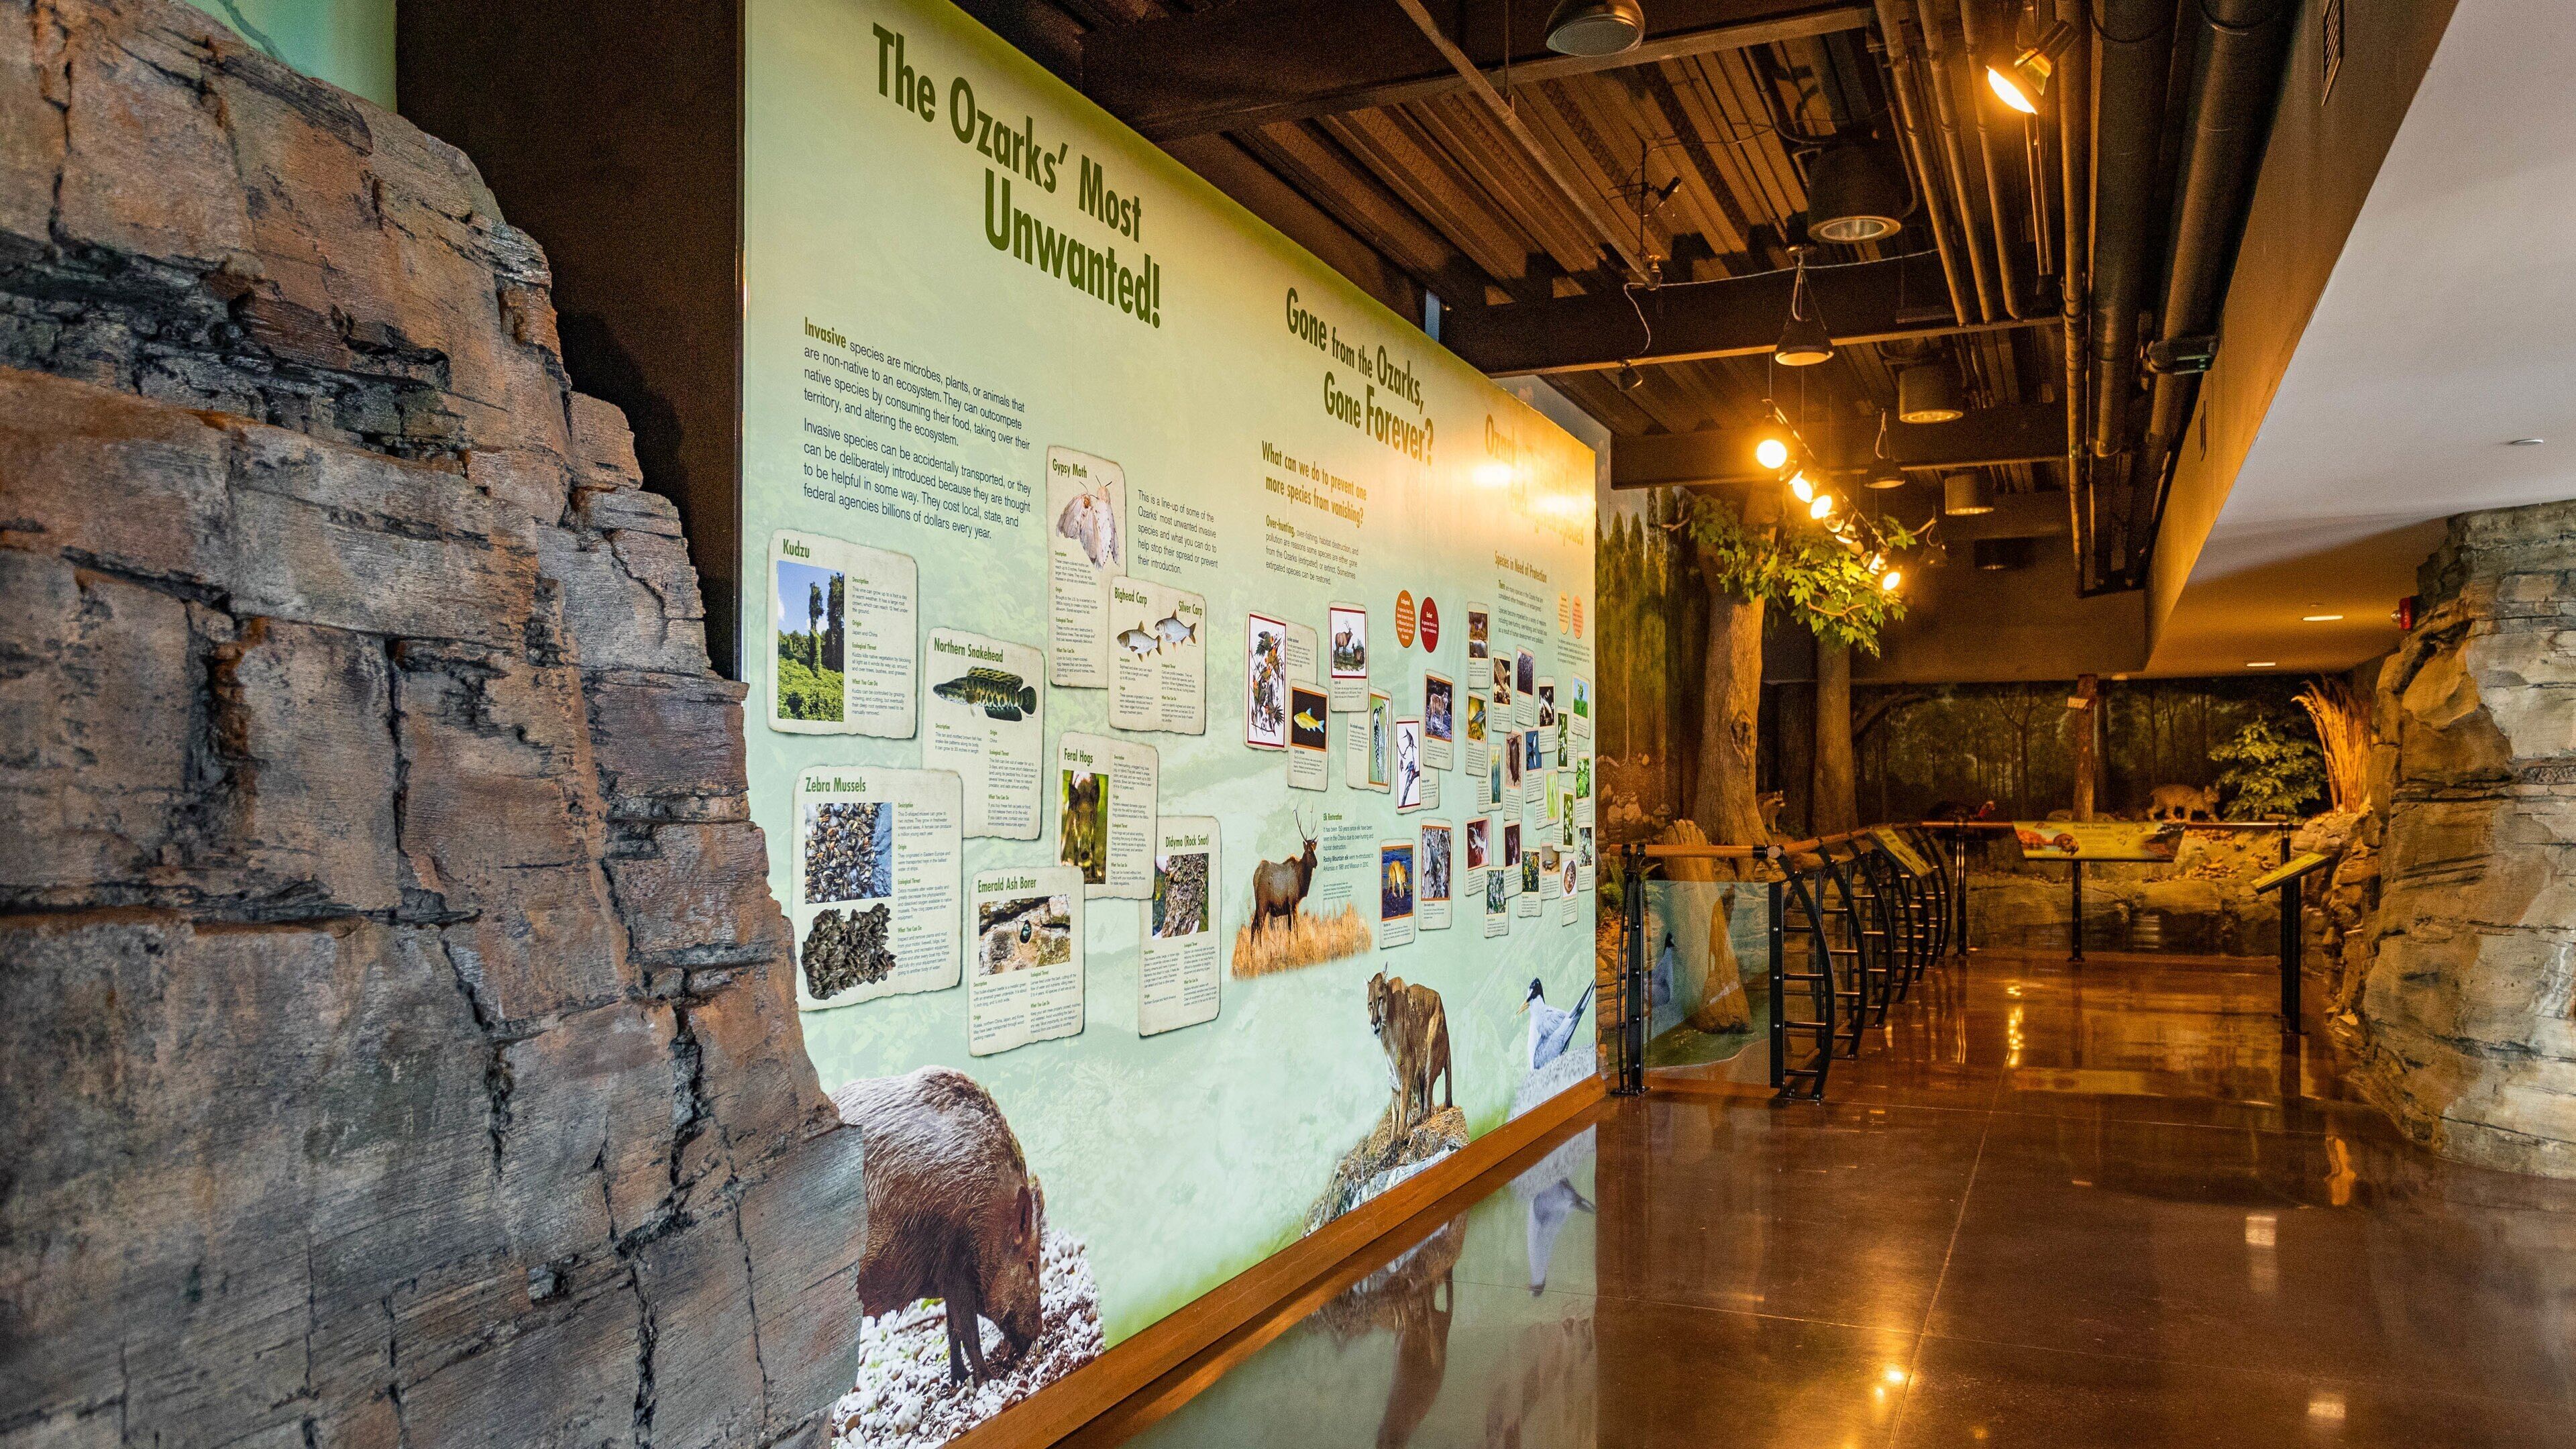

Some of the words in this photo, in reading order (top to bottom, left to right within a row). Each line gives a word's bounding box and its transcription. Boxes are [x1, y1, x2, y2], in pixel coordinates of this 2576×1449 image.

[873, 21, 935, 122] The
[1079, 155, 1141, 243] Most
[985, 168, 1161, 329] Unwanted!
[805, 317, 846, 348] Invasive
[850, 341, 883, 363] species
[888, 355, 900, 368] are
[904, 361, 943, 384] microbes,
[946, 376, 969, 394] plants,
[973, 386, 980, 396] or
[983, 389, 1010, 407] animals
[1012, 398, 1024, 413] that
[1287, 287, 1327, 352] Gone
[1332, 326, 1354, 368] from
[1358, 345, 1373, 378] the
[1377, 345, 1424, 415] Ozarks,
[805, 347, 819, 360] are
[824, 352, 868, 377] non-native
[872, 368, 879, 380] to
[883, 373, 893, 386] an
[896, 379, 941, 402] ecosystem.
[943, 392, 961, 412] They
[964, 401, 977, 415] can
[980, 408, 1022, 430] outcompete
[805, 369, 830, 386] native
[835, 379, 869, 398] species
[873, 388, 882, 405] by
[885, 396, 930, 420] consuming
[933, 409, 949, 424] their
[953, 415, 971, 433] food,
[974, 425, 996, 441] taking
[998, 432, 1013, 444] over
[1015, 435, 1030, 449] their
[804, 388, 841, 412] territory,
[845, 402, 861, 417] and
[865, 408, 896, 430] altering
[899, 417, 911, 431] the
[914, 425, 959, 446] ecosystem.
[1324, 371, 1360, 429] Gone
[1366, 384, 1434, 466] Forever?
[804, 418, 840, 440] Invasive
[843, 431, 878, 451] species
[881, 442, 896, 456] can
[900, 445, 910, 460] be
[913, 451, 959, 476] accidentally
[961, 465, 1005, 488] transported,
[1008, 480, 1015, 490] or
[1017, 480, 1031, 497] they
[804, 443, 821, 455] can
[825, 445, 836, 460] be
[840, 450, 889, 478] deliberately
[892, 464, 935, 487] introduced
[938, 476, 971, 496] because
[973, 486, 988, 502] they
[991, 493, 1002, 504] are
[1004, 495, 1030, 513] thought
[1053, 458, 1070, 478] Gypsy
[1073, 463, 1087, 478] Moth
[1262, 441, 1282, 467] What
[1285, 455, 1296, 472] can
[1299, 461, 1309, 477] we
[1311, 461, 1320, 482] do
[1322, 469, 1328, 485] to
[1331, 475, 1354, 496] prevent
[1356, 486, 1366, 500] one
[804, 463, 812, 476] to
[816, 464, 828, 480] be
[832, 468, 861, 490] helpful
[864, 476, 871, 490] in
[875, 483, 898, 497] some
[901, 491, 918, 504] way.
[922, 491, 941, 511] They
[943, 500, 959, 513] cost
[962, 502, 981, 520] local,
[984, 509, 1003, 524] state,
[1006, 516, 1018, 527] and
[804, 483, 835, 503] federal
[839, 495, 879, 513] agencies
[882, 502, 910, 521] billions
[913, 511, 920, 523] of
[924, 513, 949, 530] dollars
[953, 523, 972, 539] every
[975, 527, 991, 540] year.
[1138, 489, 1149, 503] This
[1151, 496, 1155, 504] is
[1157, 498, 1159, 506] a
[1161, 497, 1178, 513] line-up
[1180, 503, 1184, 513] of
[1186, 507, 1199, 517] some
[1201, 508, 1205, 519] of
[1266, 476, 1284, 495] more
[1287, 485, 1311, 505] species
[1313, 488, 1329, 511] from
[1332, 501, 1363, 528] vanishing?
[1138, 525, 1158, 538] species
[1160, 530, 1169, 540] and
[1171, 531, 1183, 543] what
[1185, 538, 1193, 547] you
[1195, 541, 1203, 549] can
[1204, 541, 1210, 551] do
[1212, 545, 1216, 553] to
[1160, 513, 1172, 525] most
[1174, 519, 1197, 532] unwanted
[1199, 525, 1216, 538] invasive
[783, 539, 810, 559] Kudzu
[1138, 539, 1149, 551] help
[1151, 543, 1162, 553] stop
[1164, 545, 1174, 557] their
[1176, 549, 1193, 562] spread
[1201, 556, 1218, 568] prevent
[1138, 554, 1148, 566] their
[1151, 558, 1181, 574] introduction.
[1114, 587, 1134, 603] Bighead
[1136, 592, 1147, 606] Carp
[1179, 600, 1190, 614] Silver
[1192, 604, 1202, 619] Carp
[934, 637, 965, 656] Northern
[968, 643, 1003, 663] Snakehead
[1064, 748, 1077, 761] Feral
[1079, 750, 1093, 766] Hogs
[806, 777, 830, 792] Zebra
[834, 777, 866, 792] Mussels
[1166, 835, 1183, 850] Didymo
[1185, 835, 1196, 847] (Rock
[1198, 834, 1209, 846] Snot)
[978, 877, 1004, 893] Emerald
[1006, 877, 1018, 890] Ash
[1020, 876, 1036, 890] Borer
